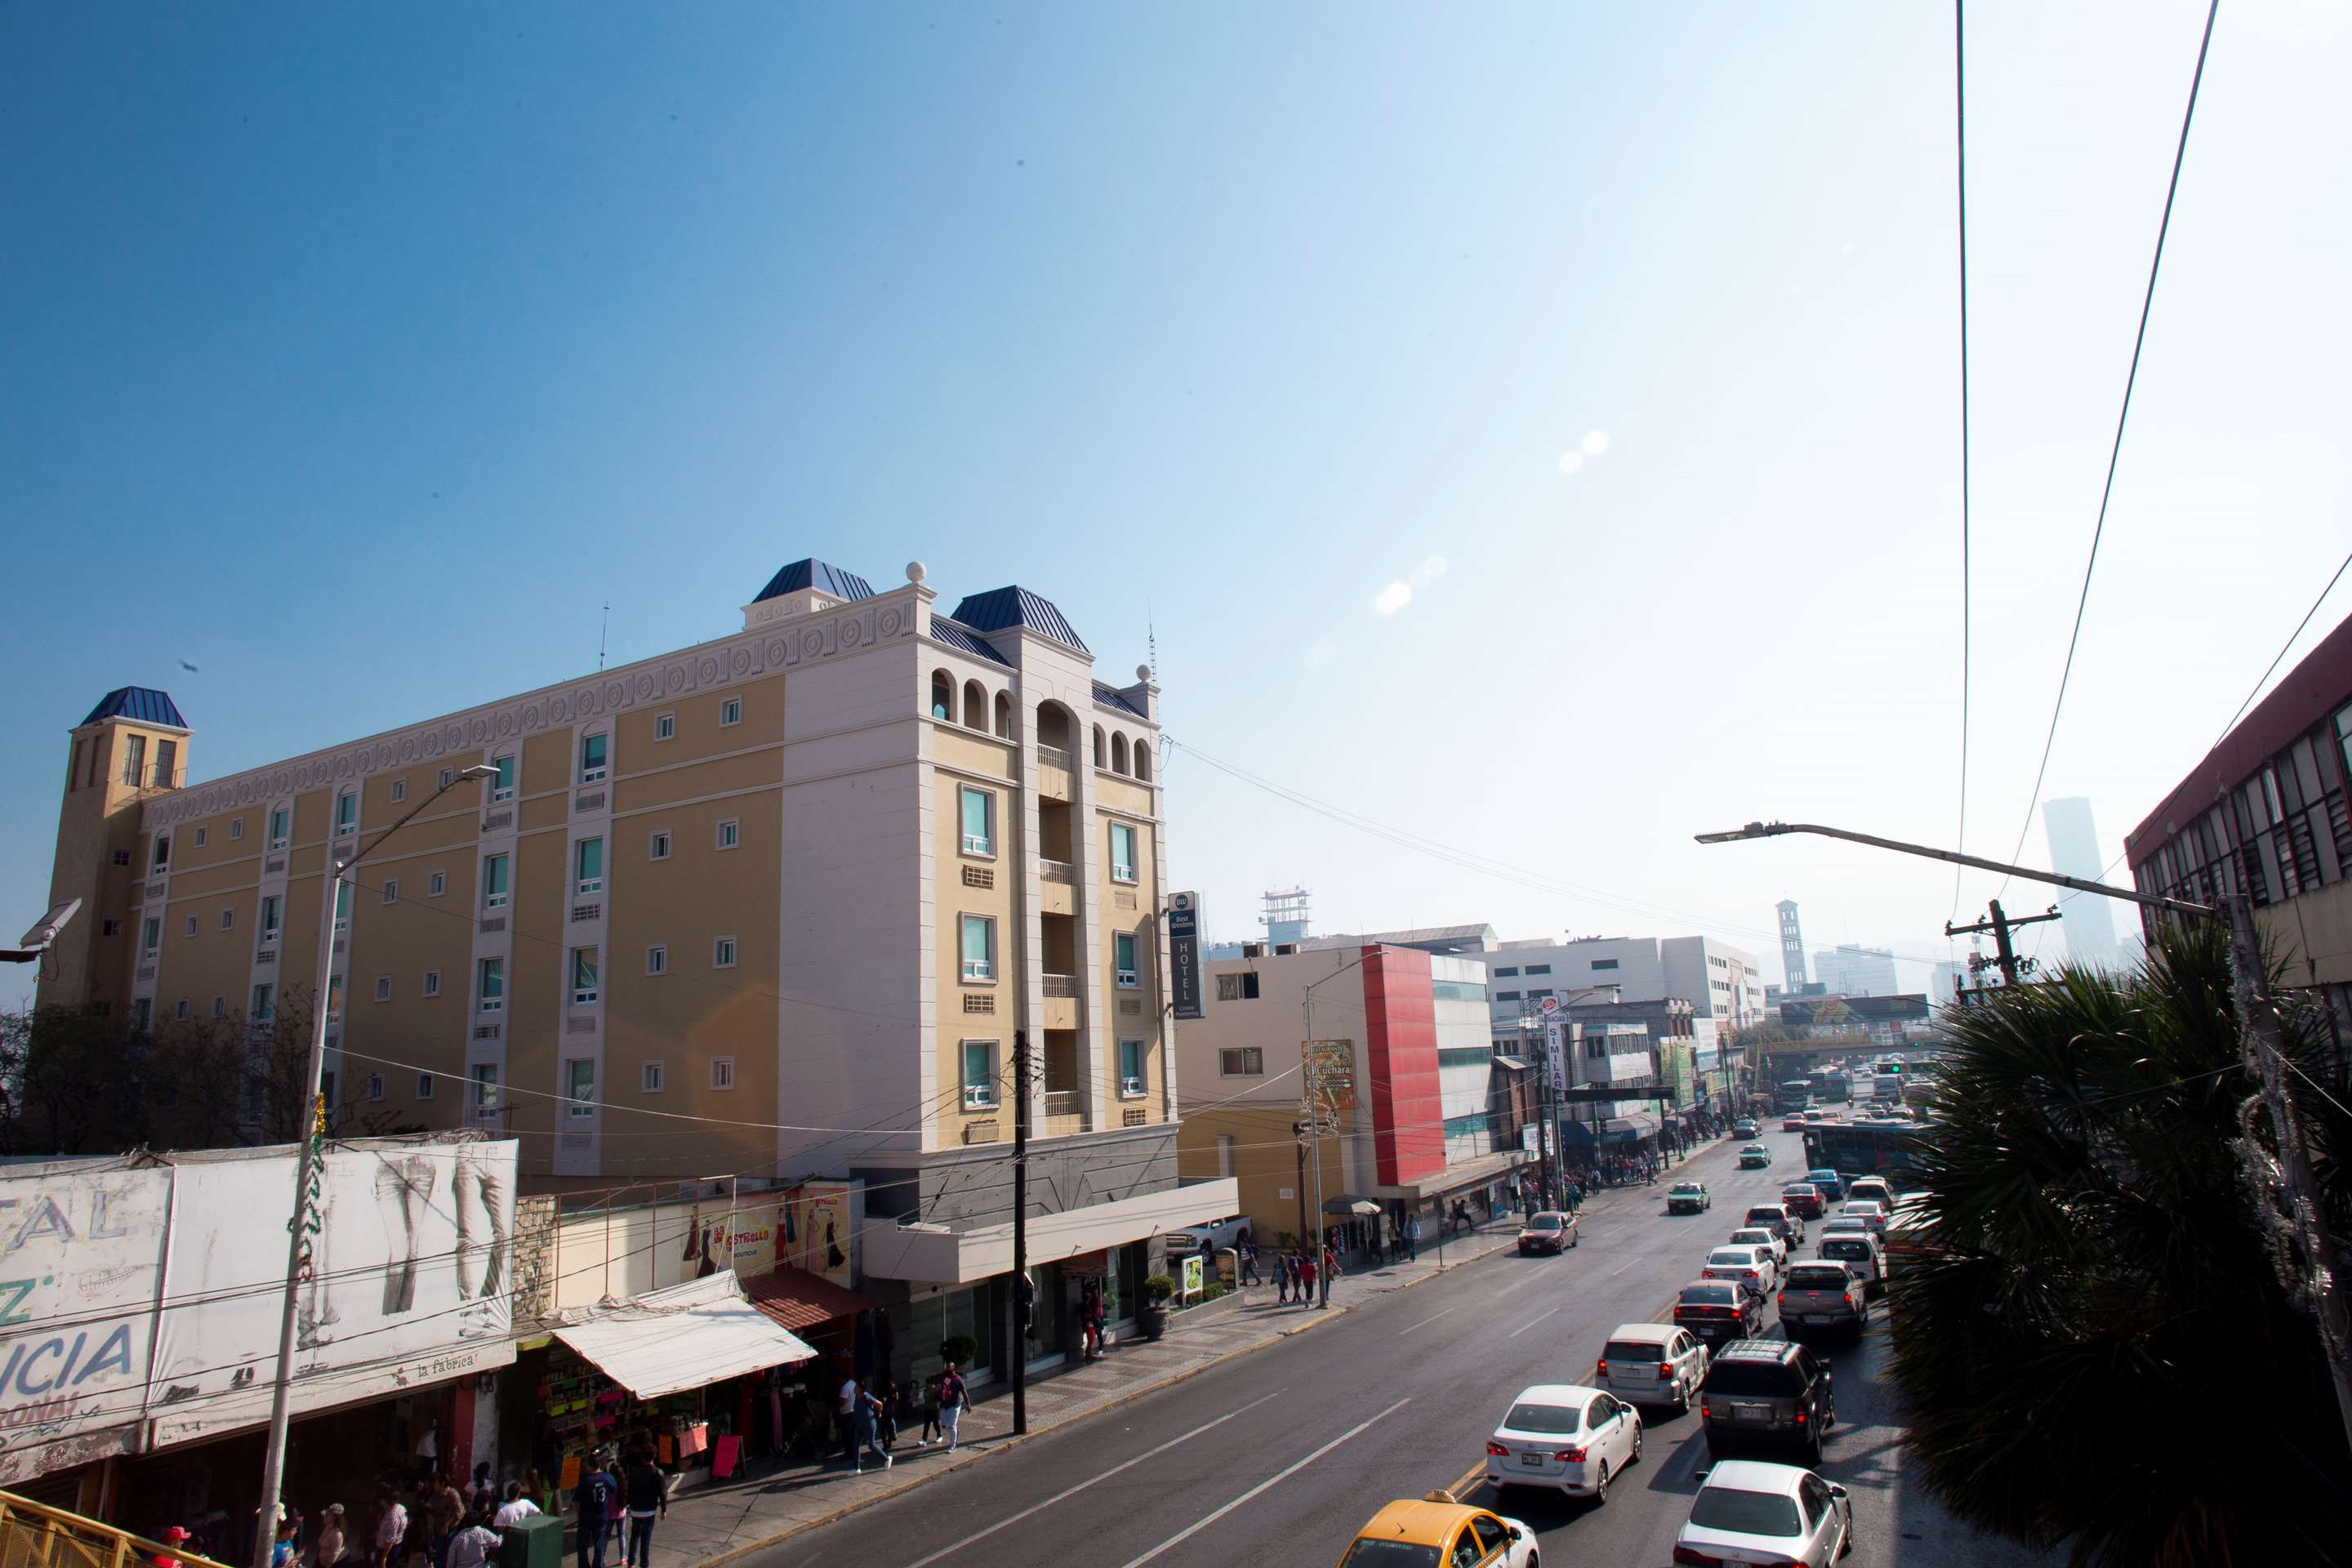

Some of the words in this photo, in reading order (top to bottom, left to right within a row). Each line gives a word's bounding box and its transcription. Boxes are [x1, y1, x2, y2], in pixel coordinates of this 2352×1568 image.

[1179, 942, 1190, 1000] HOTEL
[1317, 1065, 1350, 1075] Cuchara
[0, 1190, 131, 1251] AL
